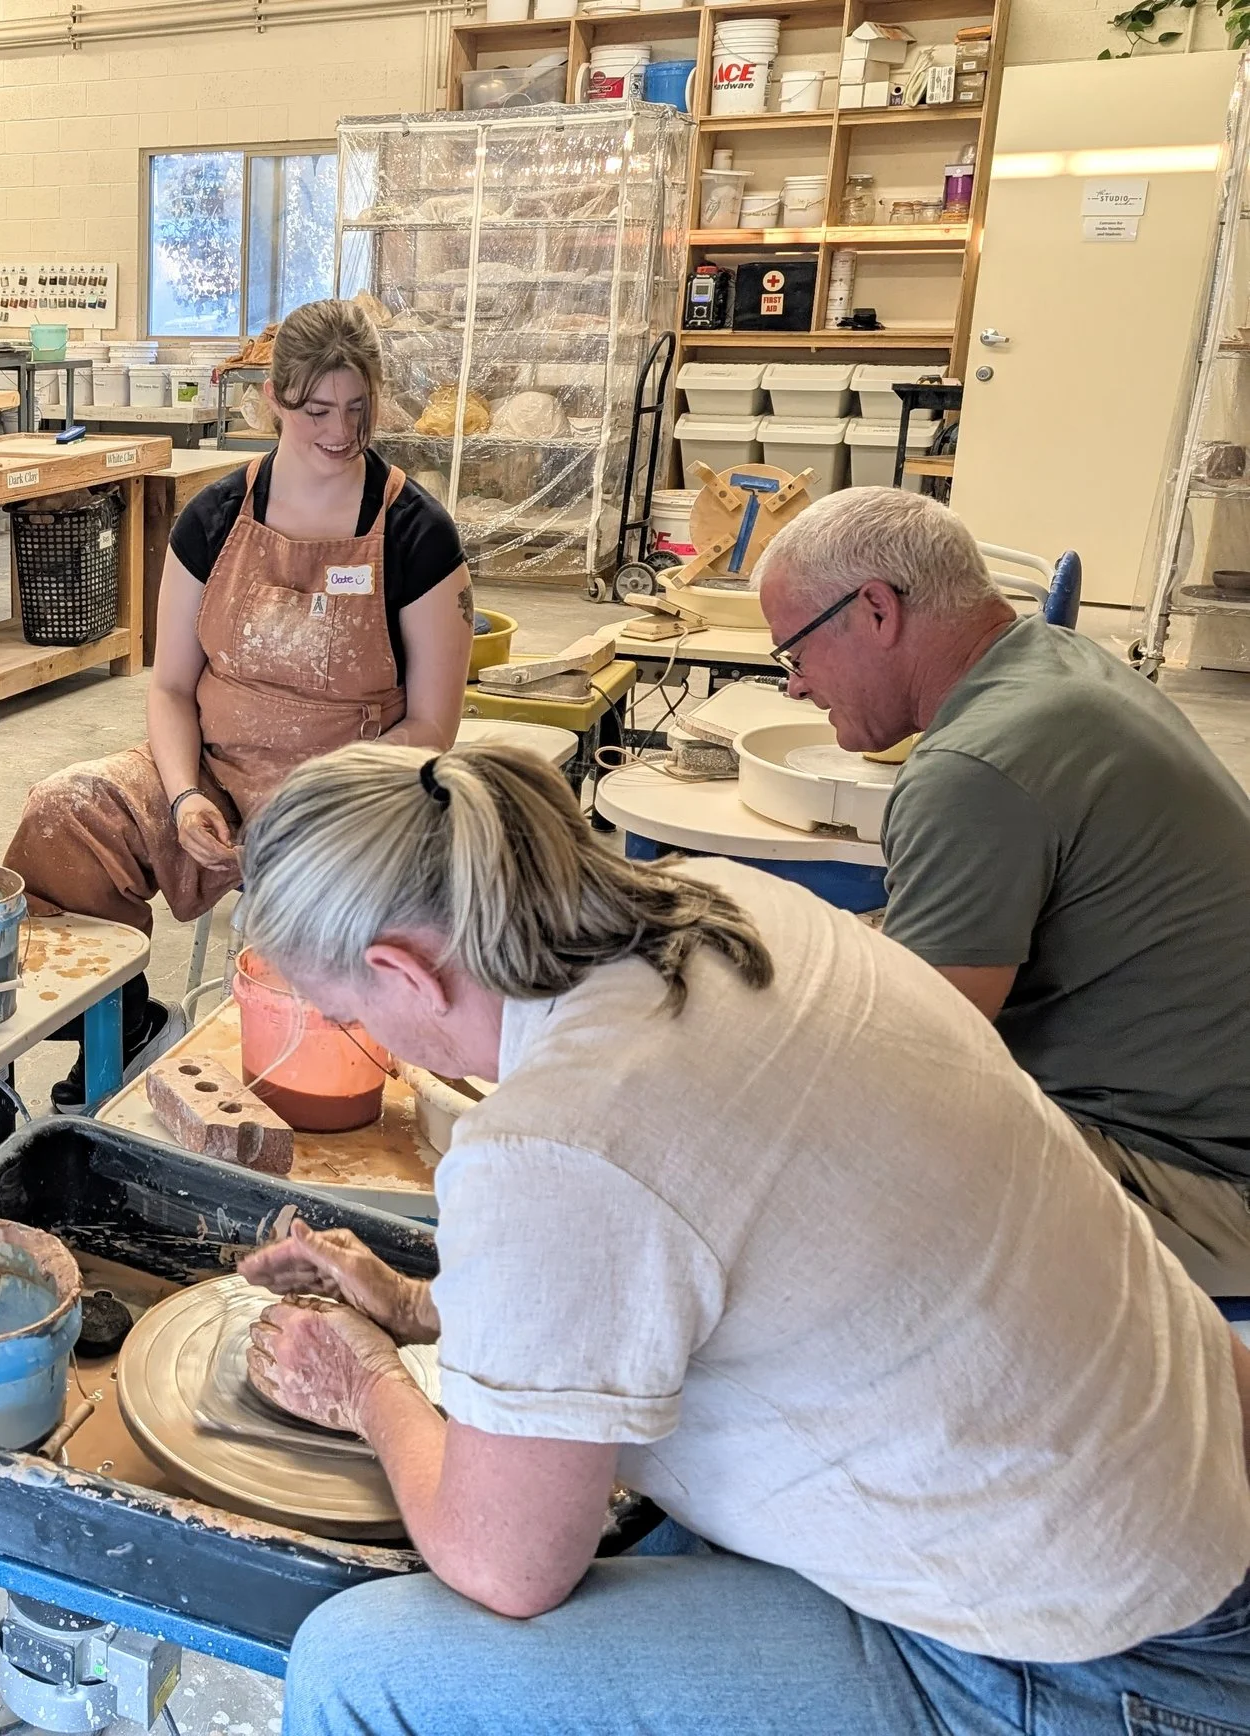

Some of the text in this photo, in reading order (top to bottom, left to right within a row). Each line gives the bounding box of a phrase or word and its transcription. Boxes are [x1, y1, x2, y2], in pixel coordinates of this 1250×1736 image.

[714, 62, 757, 83] ACE
[763, 296, 782, 304] FIRST
[108, 451, 136, 464] White Clay
[8, 472, 38, 486] Dark Clay
